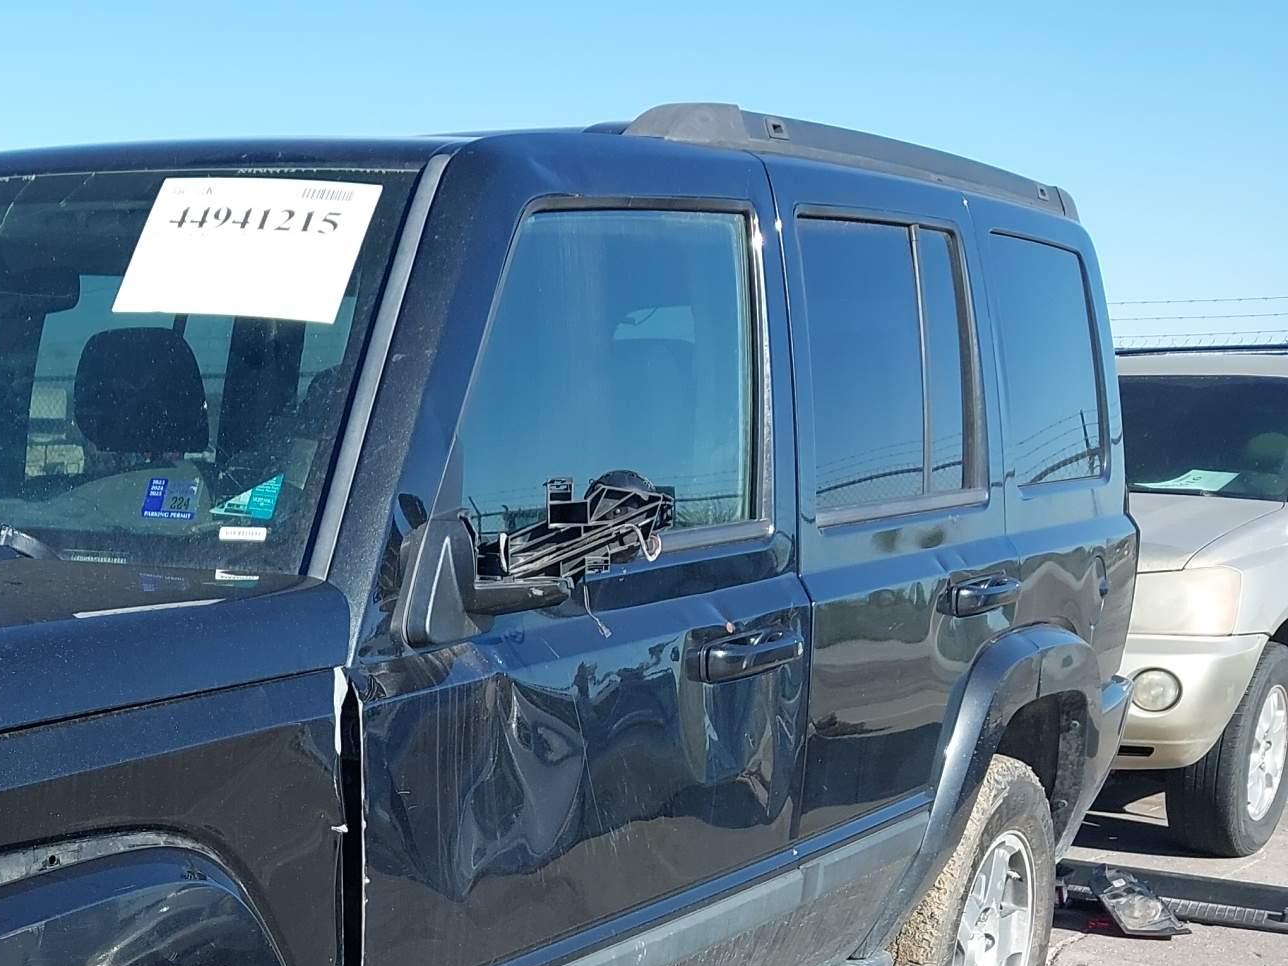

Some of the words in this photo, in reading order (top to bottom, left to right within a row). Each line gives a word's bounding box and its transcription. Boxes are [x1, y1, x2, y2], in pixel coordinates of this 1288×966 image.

[169, 206, 343, 234] 44941215
[170, 496, 191, 510] 224
[170, 512, 192, 520] PERMIT
